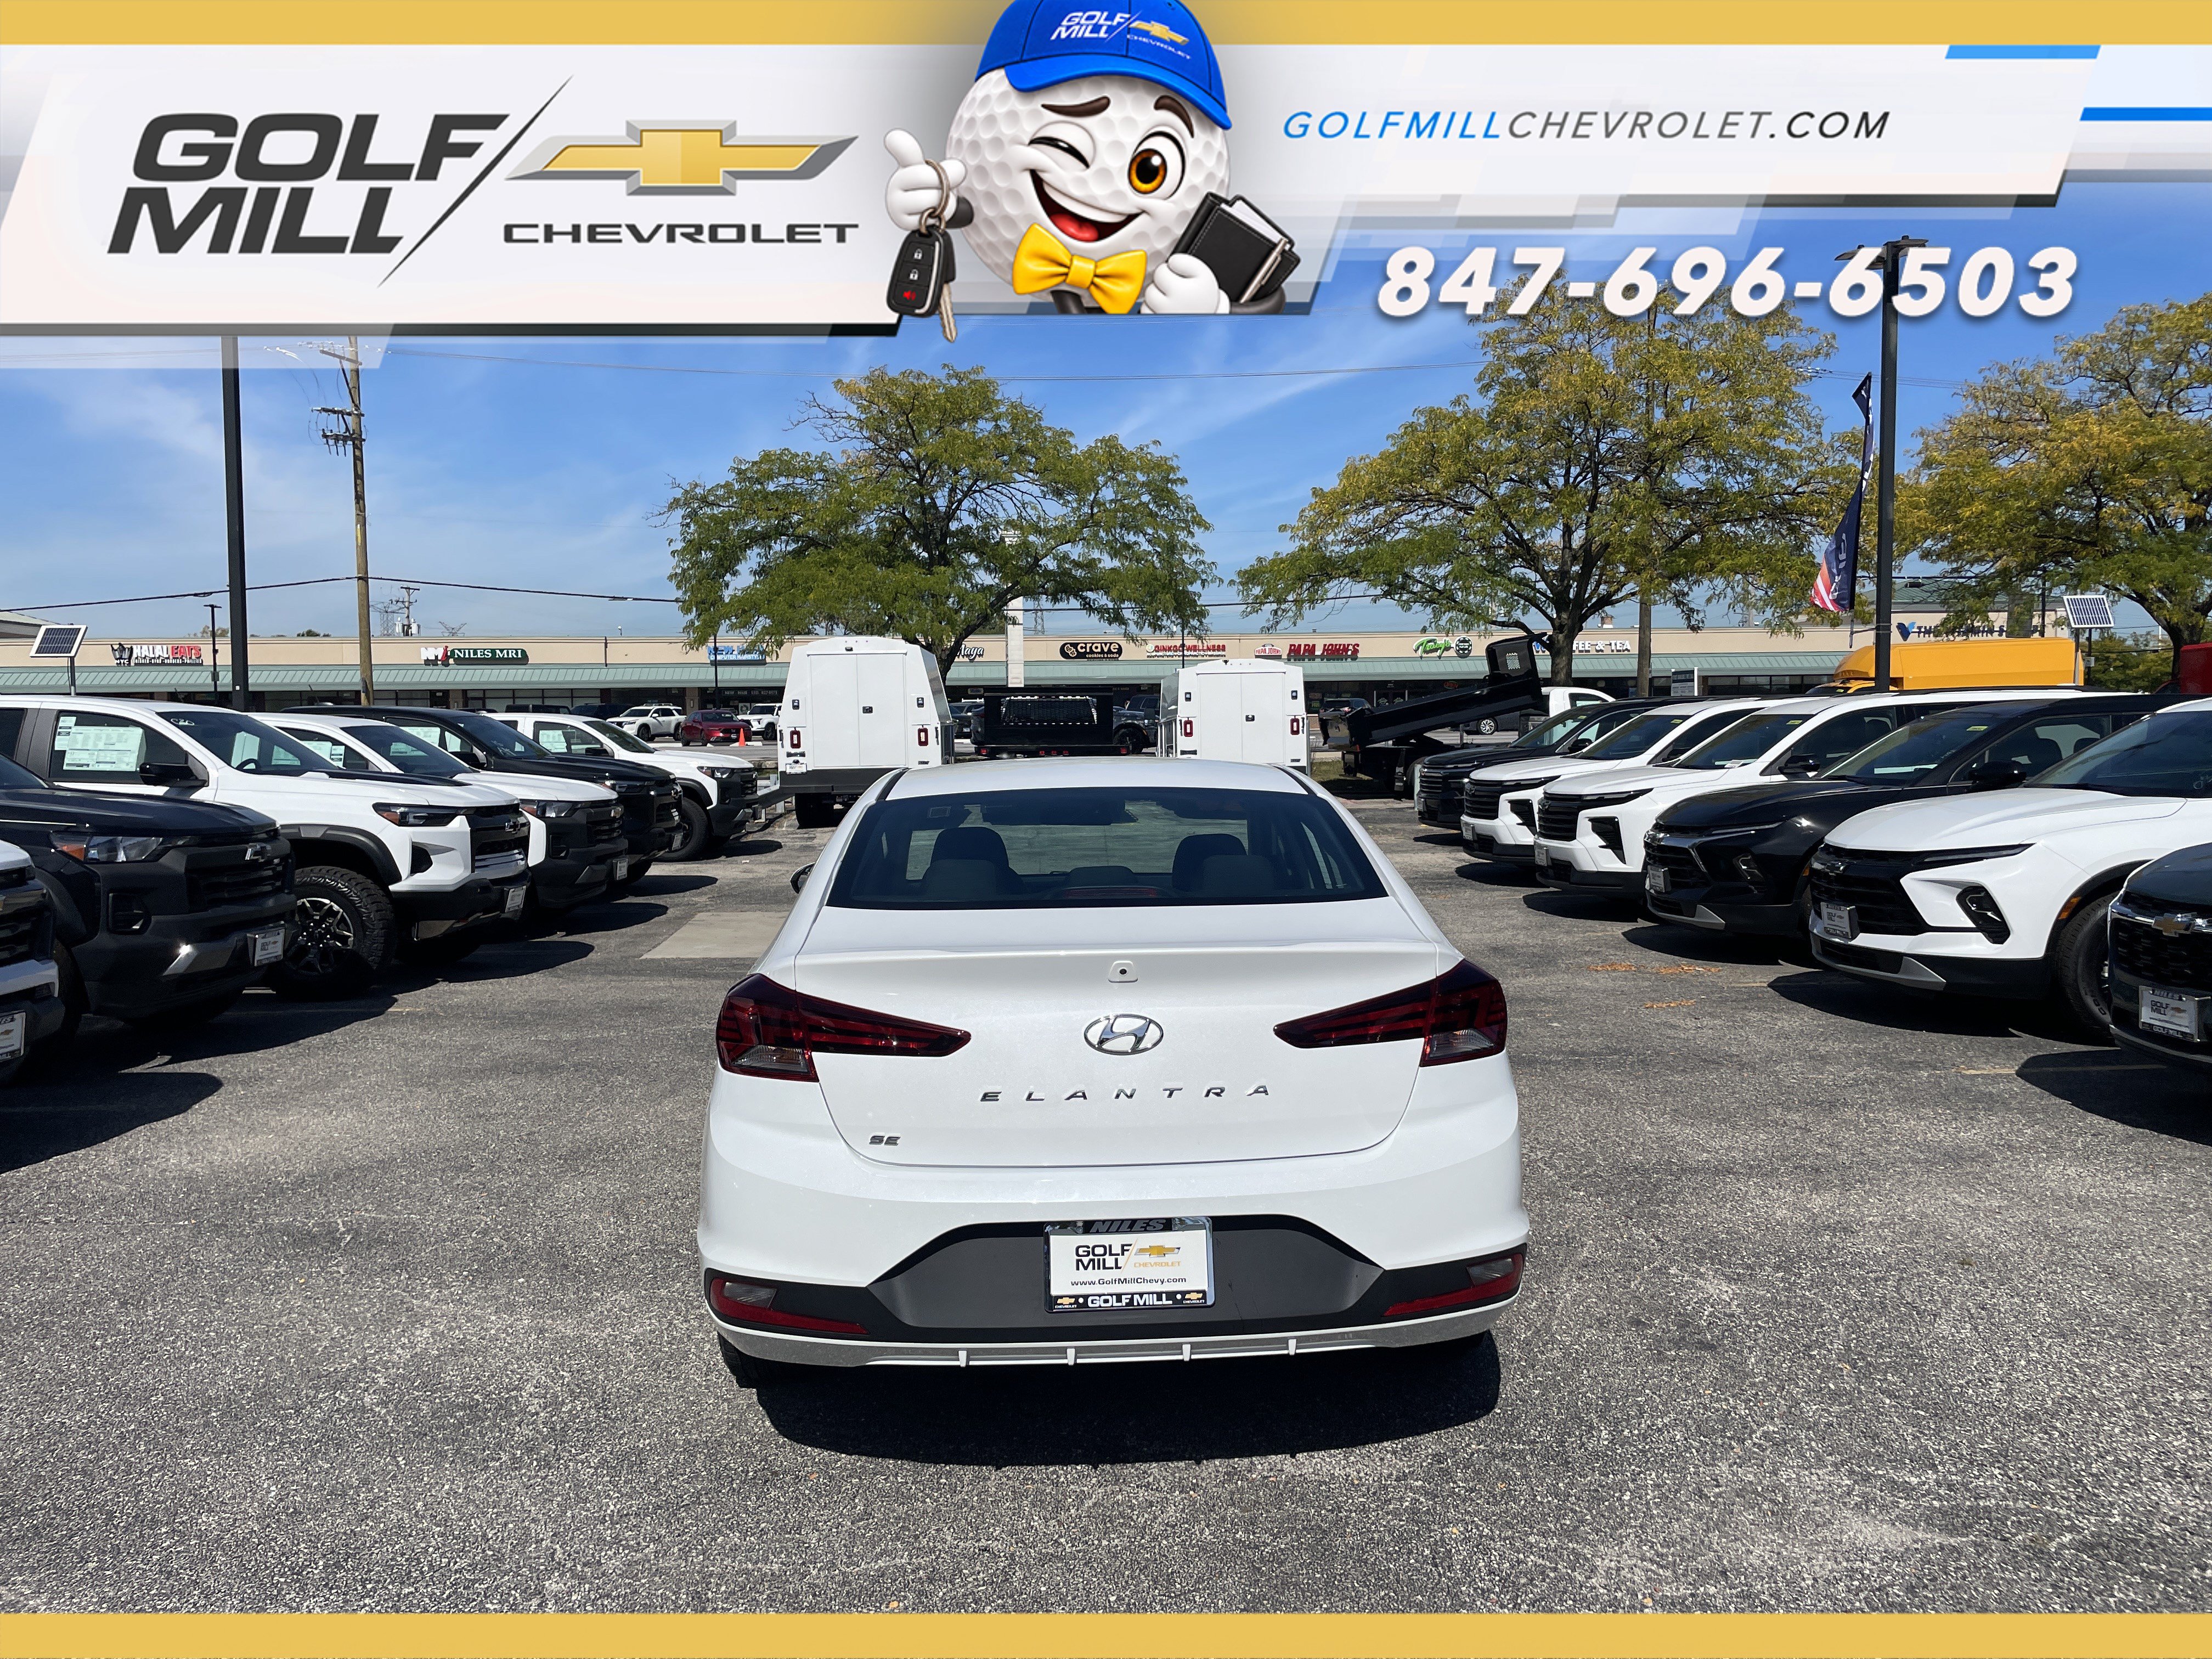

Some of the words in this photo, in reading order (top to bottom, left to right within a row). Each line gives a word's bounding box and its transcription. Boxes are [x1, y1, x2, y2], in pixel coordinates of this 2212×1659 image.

[133, 645, 169, 658] HALAL
[171, 645, 202, 658] EATS
[1077, 643, 1119, 652] crave
[1288, 644, 1316, 656] PAPA
[1321, 643, 1359, 656] JOHN'S
[1573, 641, 1591, 651] FEE
[1595, 641, 1605, 650] &
[1610, 641, 1630, 650] TEA
[454, 649, 492, 658] NILES
[495, 649, 522, 658] MRI
[2151, 1000, 2170, 1009] GOLF
[2151, 1006, 2166, 1016] MILL
[979, 1084, 1269, 1102] ELANTRA
[868, 1135, 901, 1146] SE
[1089, 1218, 1166, 1233] NILES
[1075, 1243, 1133, 1257] GOLF
[1075, 1257, 1123, 1271] MILL
[1071, 1277, 1187, 1286] www.GolfMillChevy.com
[1087, 1294, 1132, 1307] GOLF
[1133, 1293, 1173, 1306] MILL
